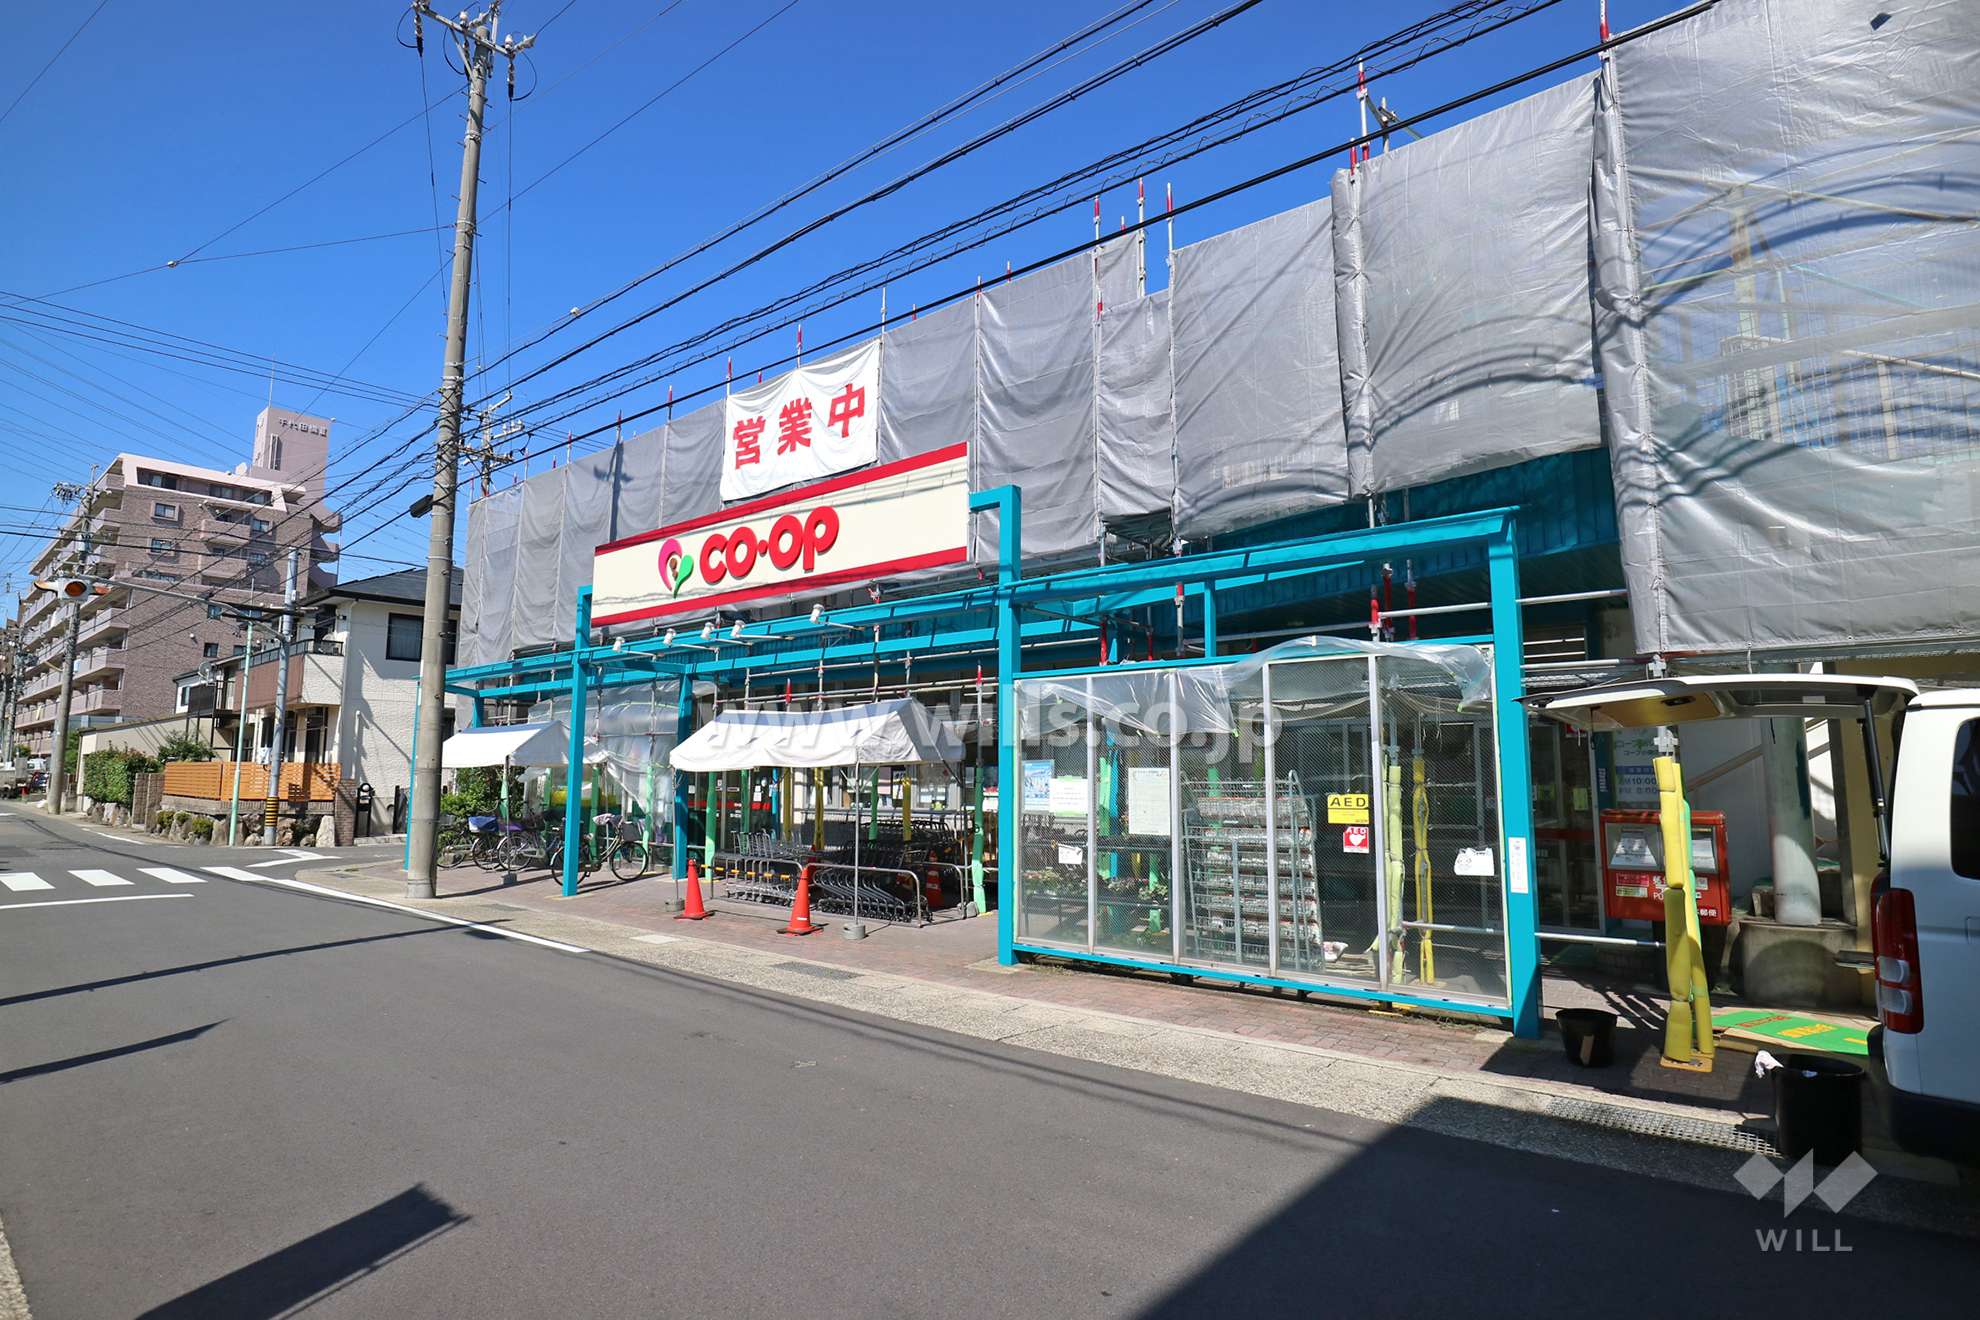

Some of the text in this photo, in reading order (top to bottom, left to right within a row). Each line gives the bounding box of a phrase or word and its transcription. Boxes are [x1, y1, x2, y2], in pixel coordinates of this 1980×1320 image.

[733, 383, 865, 470] 営業中
[1330, 797, 1366, 807] AED
